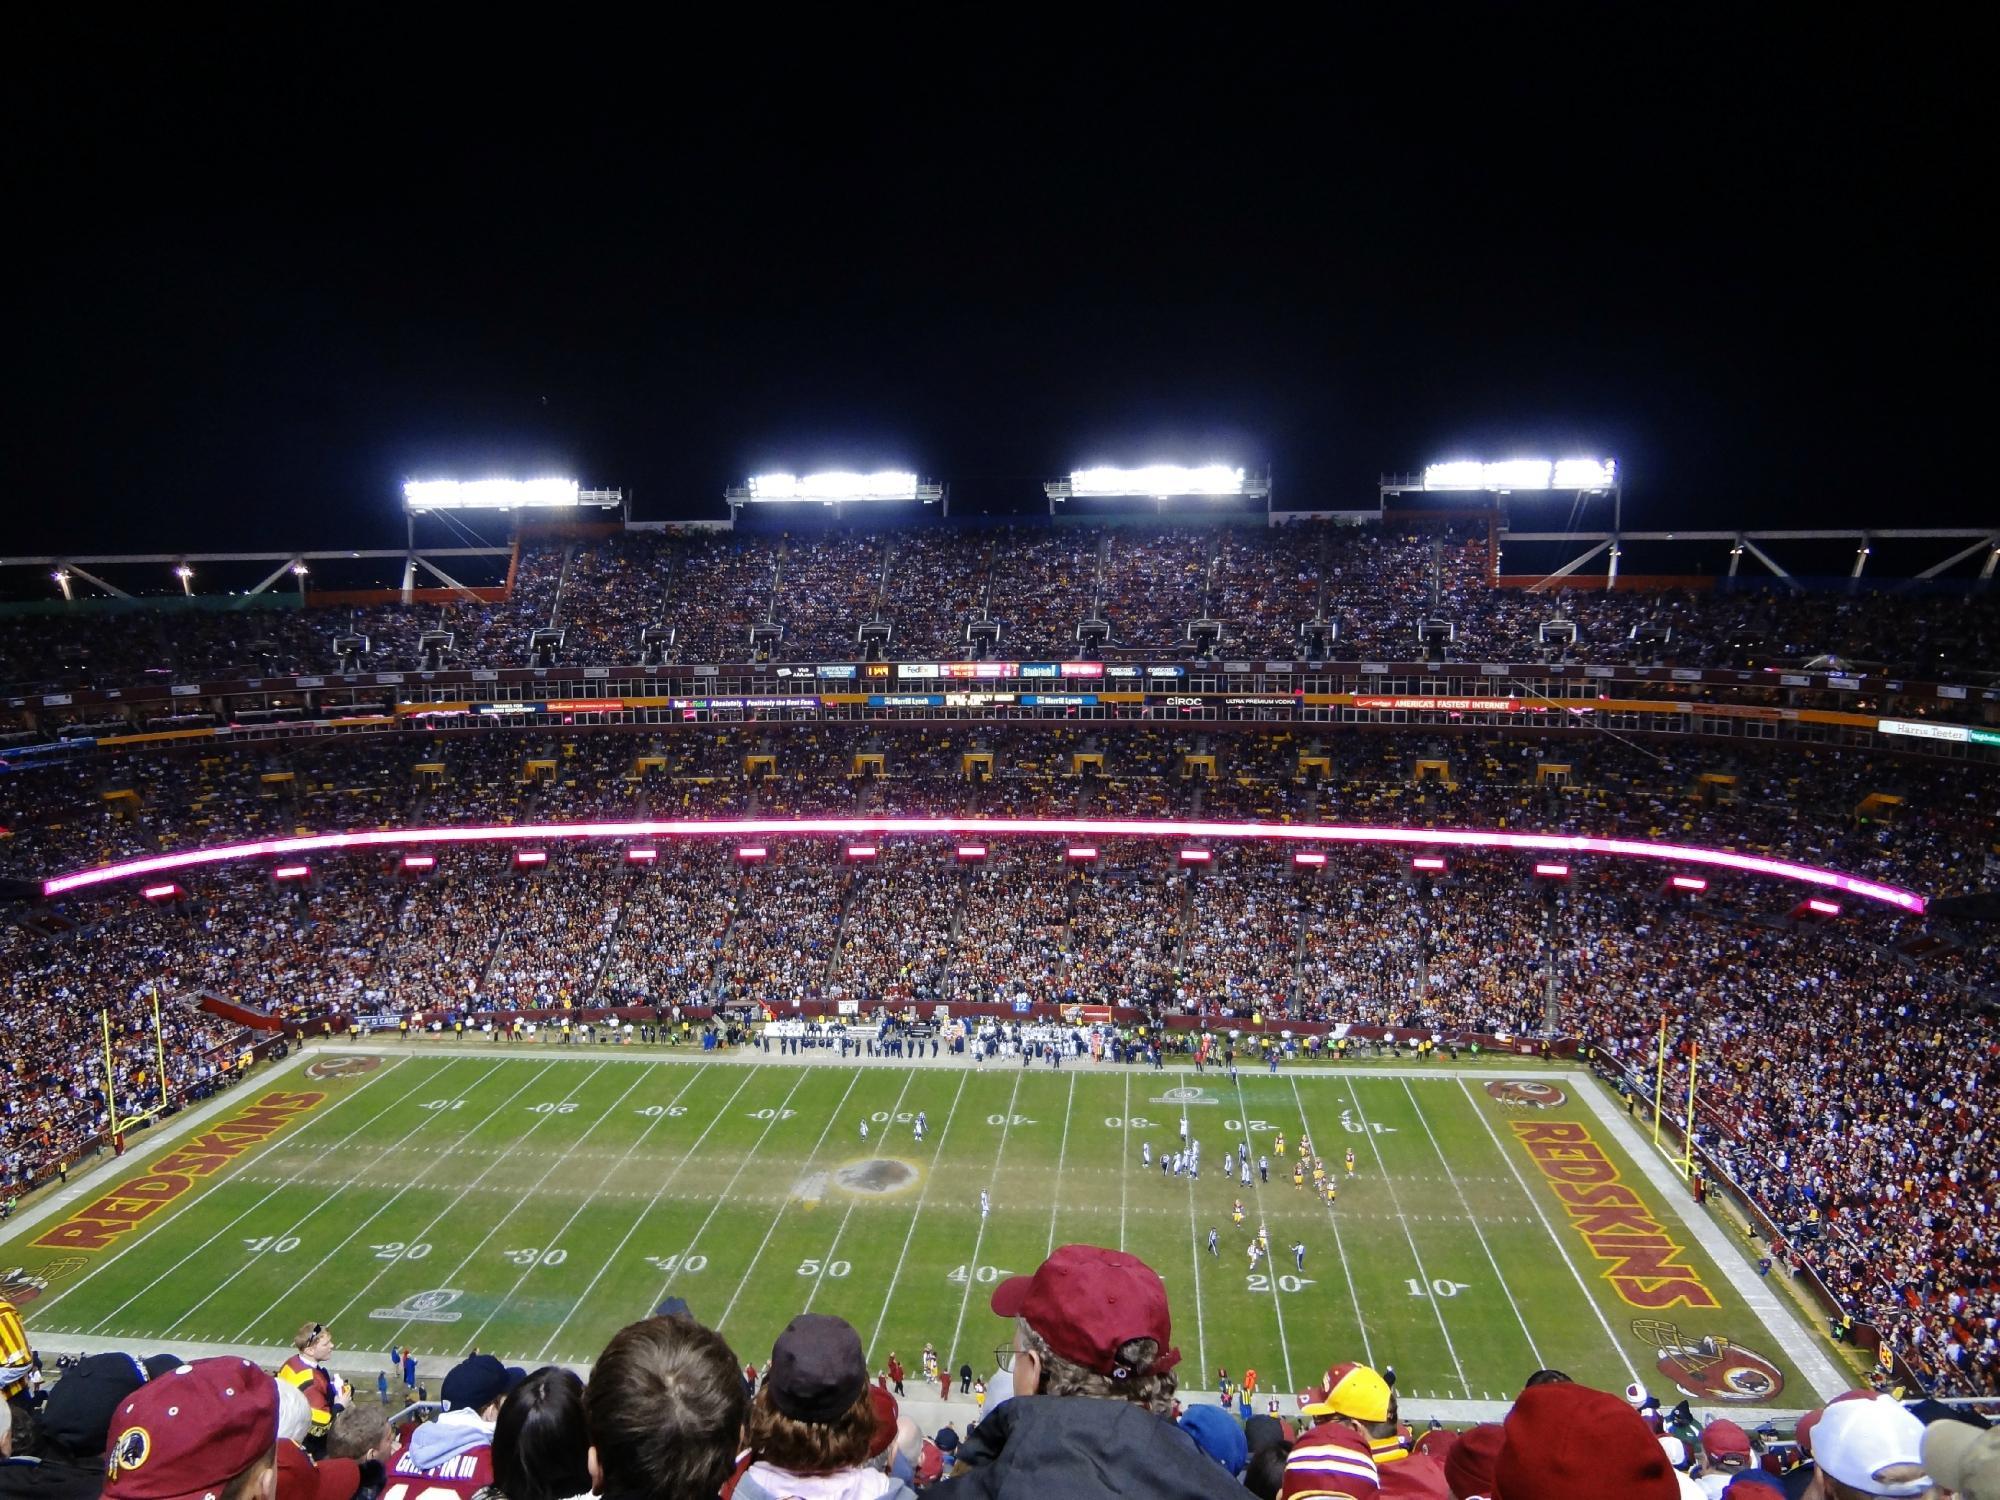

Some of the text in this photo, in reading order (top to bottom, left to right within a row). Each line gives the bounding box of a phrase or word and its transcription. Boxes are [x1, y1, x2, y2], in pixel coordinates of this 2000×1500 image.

[1023, 664, 1056, 677] StubHub!
[711, 699, 743, 708] Absolutely.
[746, 699, 775, 707] Positively
[892, 697, 929, 706] Merrill Lynch
[1044, 697, 1083, 706] Merrill Lynch
[1394, 699, 1434, 708] AMERICA'S
[1437, 700, 1469, 708] FASTEST
[1472, 701, 1510, 709] INTERNET
[1897, 723, 1963, 739] Harris Teeter
[1015, 1002, 1027, 1012] 12
[379, 1016, 400, 1025] CARD
[430, 1099, 469, 1111] 10
[536, 1102, 580, 1114] 20
[645, 1105, 688, 1117] 30
[756, 1108, 798, 1121] 40
[870, 1111, 914, 1124] 50
[986, 1114, 1030, 1126] 40
[1104, 1117, 1150, 1129] 30
[1223, 1119, 1271, 1131] 20
[26, 1091, 328, 1251] REDSKINS
[1508, 1120, 1722, 1309] REDSKINS
[248, 1236, 302, 1254] 10
[374, 1242, 433, 1260] 20
[512, 1248, 568, 1266] 30
[655, 1254, 708, 1272] 40
[796, 1259, 852, 1278] 50
[947, 1265, 998, 1283] 40
[1245, 1274, 1303, 1293] 20
[1403, 1278, 1458, 1297] 10
[458, 1455, 479, 1478] III
